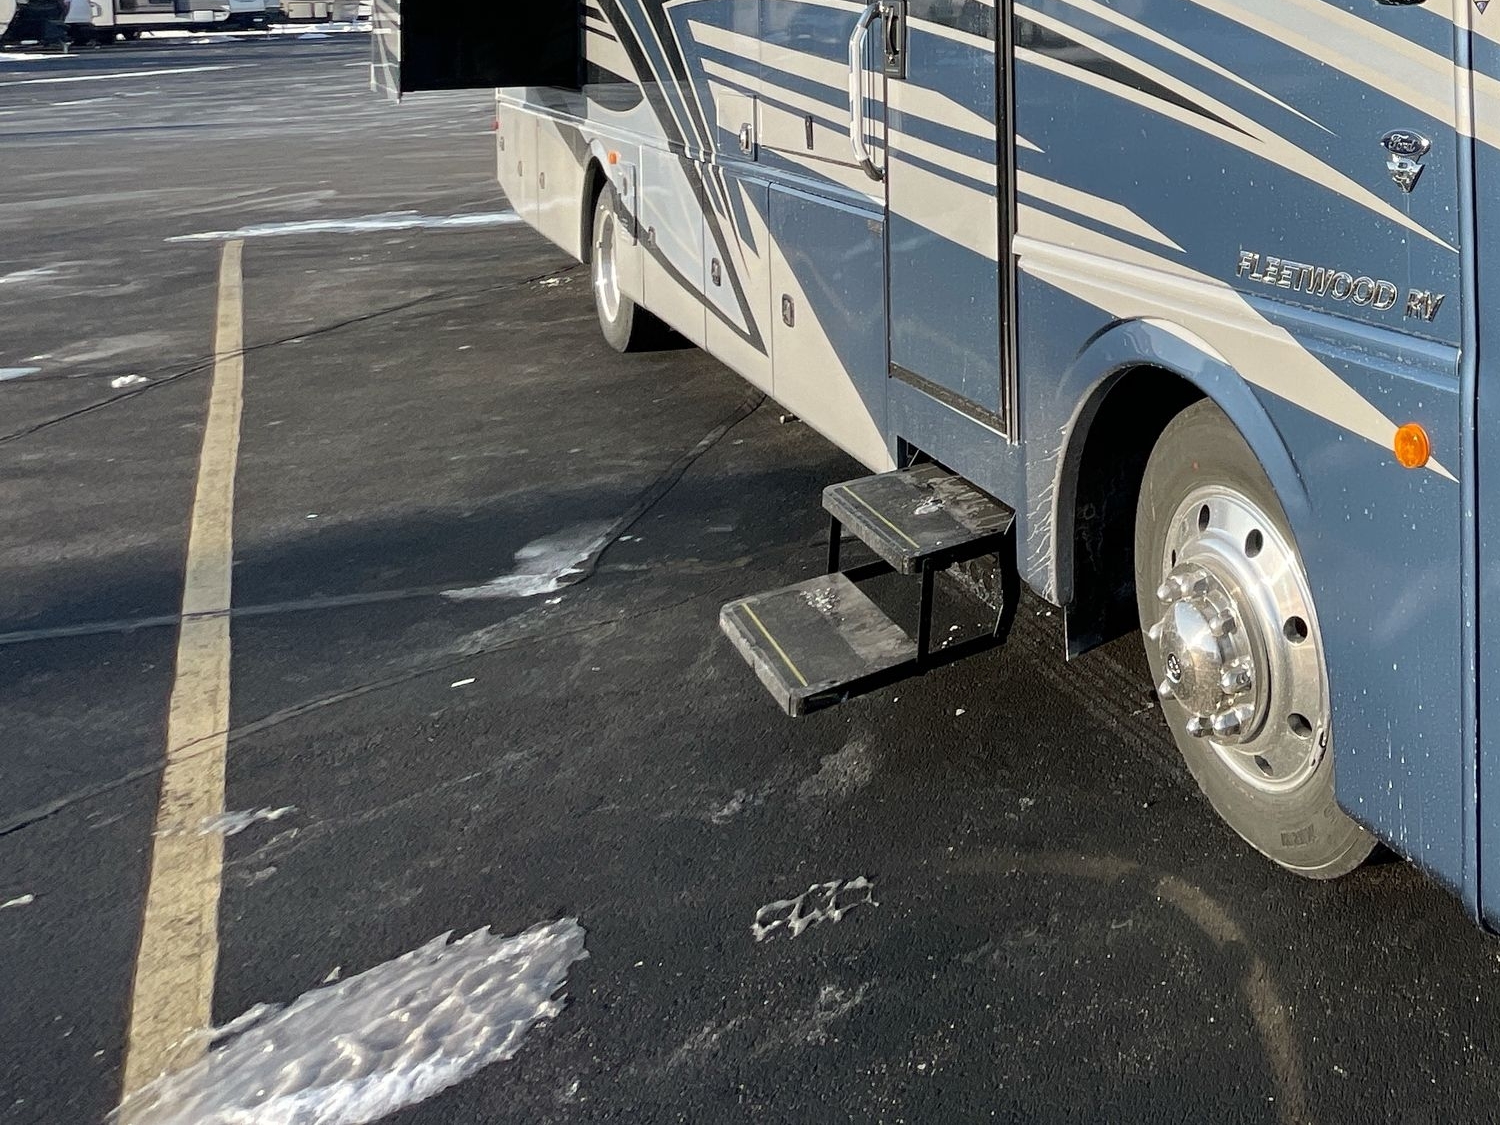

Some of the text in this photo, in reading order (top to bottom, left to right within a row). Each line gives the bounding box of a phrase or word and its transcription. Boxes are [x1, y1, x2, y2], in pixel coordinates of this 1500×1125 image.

[1388, 133, 1416, 152] Ford
[1236, 250, 1446, 323] FLEETWOOD RV
